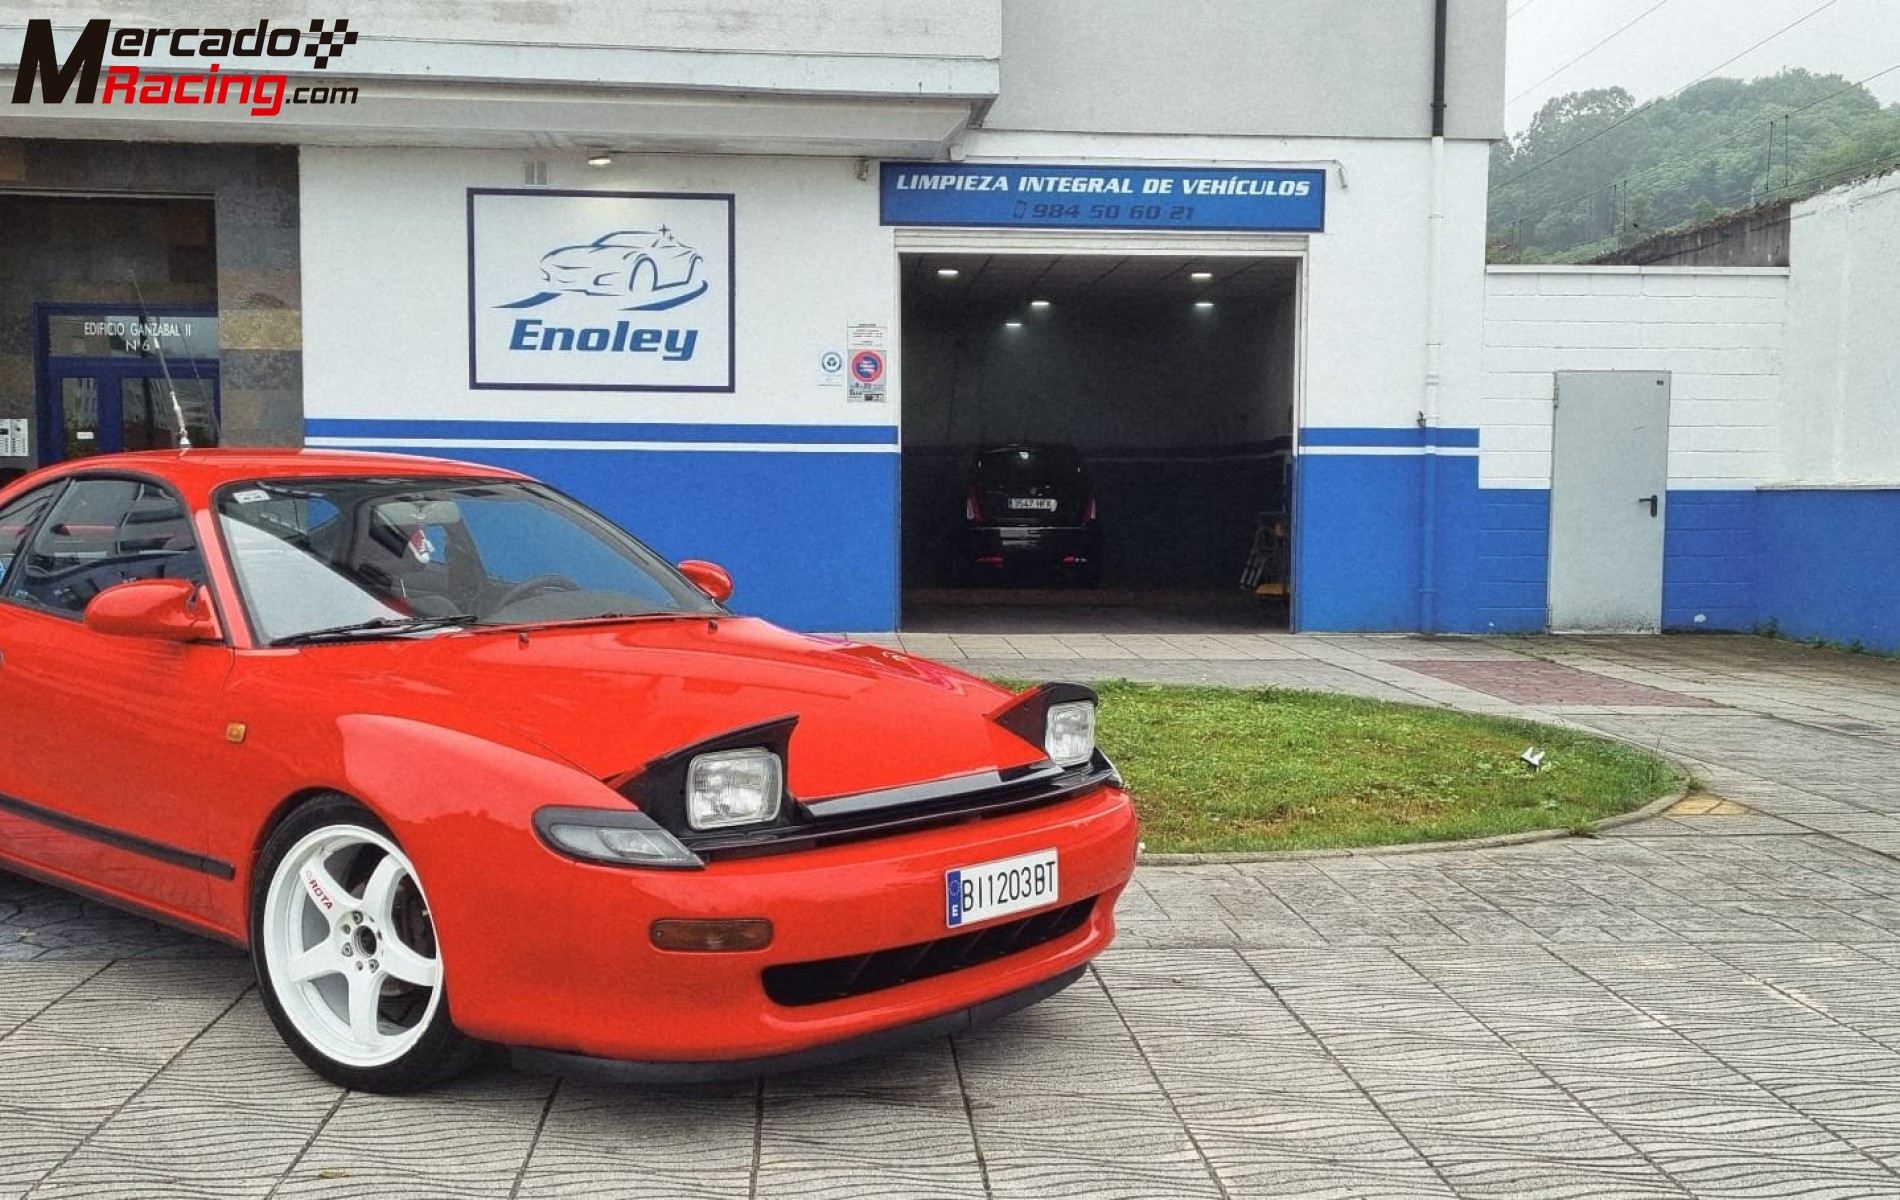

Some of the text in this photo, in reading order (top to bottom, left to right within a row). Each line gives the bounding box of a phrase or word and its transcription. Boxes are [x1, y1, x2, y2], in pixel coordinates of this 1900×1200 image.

[896, 174, 1311, 196] LIMPIEZA INTEGRAL DE VEHÍCULOS
[1032, 204, 1195, 220] 984 50 60 21
[84, 322, 191, 337] EDIFICIO GANZABAL II
[509, 319, 699, 361] Enoley
[309, 879, 333, 910] ROTA
[952, 904, 959, 917] E
